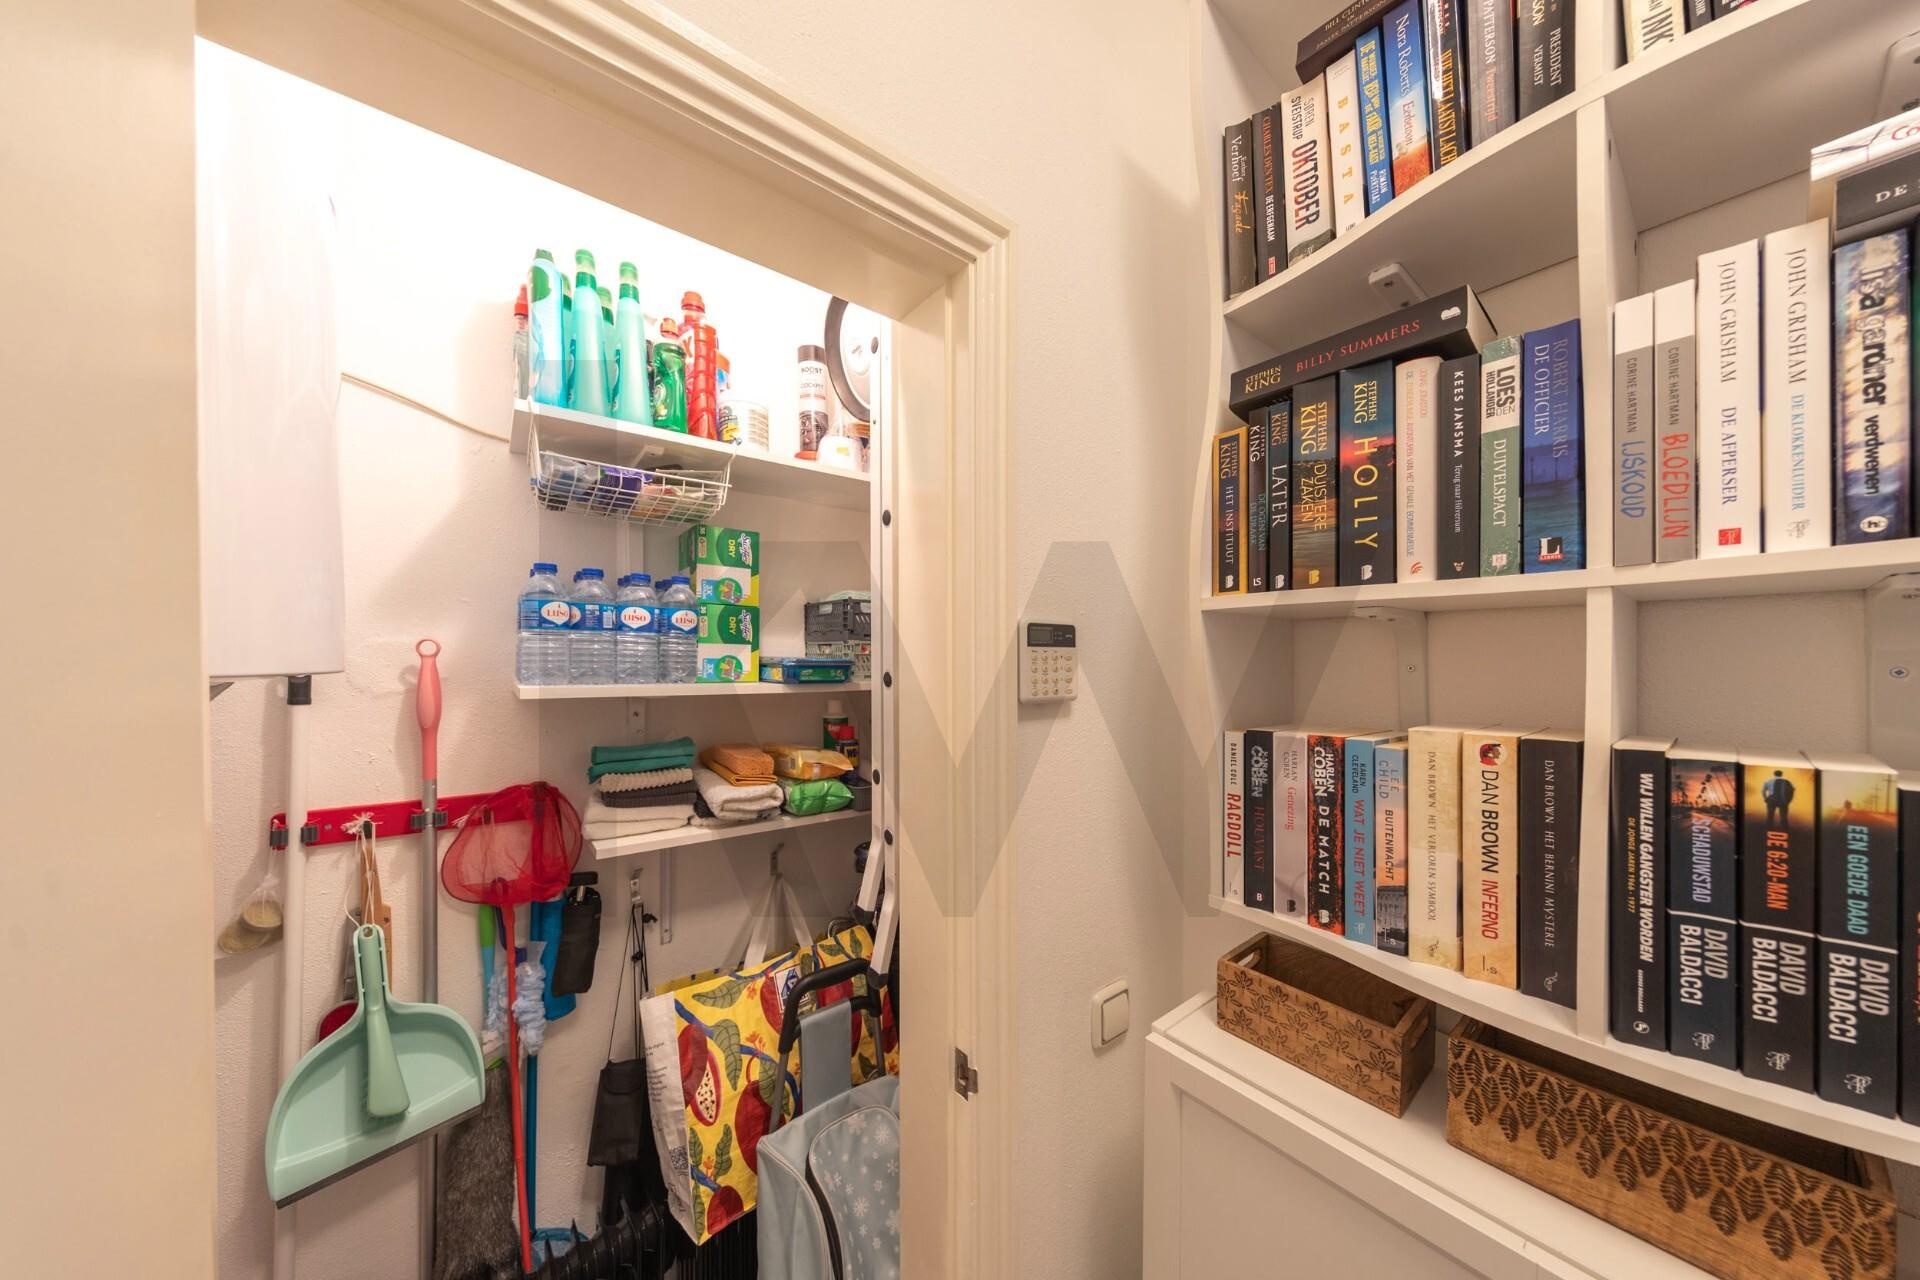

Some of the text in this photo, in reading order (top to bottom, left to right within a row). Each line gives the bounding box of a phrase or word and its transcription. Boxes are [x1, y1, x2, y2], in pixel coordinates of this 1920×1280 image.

[1396, 13, 1413, 97] Nora Roberts
[1533, 45, 1544, 86] VERMIST
[1550, 27, 1562, 87] PRESIDENT
[1291, 95, 1304, 140] SVEISTRUP
[1231, 135, 1244, 182] Verhoef
[1291, 139, 1320, 231] OKTOBER
[1265, 195, 1274, 204] DE
[1875, 184, 1908, 204] DE
[1785, 248, 1807, 298] JOHN
[1859, 262, 1892, 311] lisa
[1296, 319, 1420, 373] BILLY SUMMERS
[1788, 301, 1807, 385] GRISHAM
[1855, 313, 1895, 407] gardner
[1245, 365, 1282, 384] STEPHEN
[1245, 373, 1281, 395] KING
[1368, 380, 1377, 422] STEPHEN
[1485, 371, 1496, 419] HOLLANDER
[1496, 365, 1515, 408] LOES
[1534, 343, 1550, 436] DE OFFICIER
[1553, 337, 1569, 459] ROBERT HARRIS
[1626, 357, 1637, 433] CORINE HARTMAN
[1668, 346, 1680, 426] CORINE HARTMAN
[1717, 261, 1738, 506] JOHN GRISHAM DE AFPERSER
[1271, 414, 1282, 446] KING
[1300, 405, 1317, 455] KING
[1317, 401, 1327, 452] STEPHEN
[1354, 383, 1368, 425] KING
[1791, 394, 1805, 411] DE
[1220, 444, 1231, 480] KING
[1250, 425, 1261, 463] KING
[1453, 370, 1464, 533] KEES JANSMA Terug naar Hilversum
[1791, 412, 1806, 512] KLOKKENLUIDER
[1863, 414, 1884, 497] verdwenen
[1271, 463, 1288, 528] LATER
[1301, 476, 1314, 522] ZAKEN
[1314, 463, 1327, 531] DUISTERE
[1353, 436, 1379, 549] HOLLY
[1493, 439, 1507, 527] DUIVELSPACT
[1620, 440, 1647, 519] IJSKOUD
[1661, 432, 1691, 540] BLOEDLIJN
[728, 539, 736, 558] DRY
[1225, 486, 1234, 565] HET INSTITUUT
[547, 608, 568, 618] LUSO
[623, 613, 647, 622] LUSO
[675, 616, 696, 625] LUSO
[728, 616, 736, 636] DRY
[1251, 745, 1264, 798] COBEN
[1314, 746, 1328, 797] COBEN
[1325, 753, 1335, 793] HARLAN
[1378, 760, 1389, 799] CHILD
[1391, 769, 1399, 793] LEE
[1227, 793, 1242, 858] RAGDOLL
[1285, 786, 1297, 830] Genezing
[1627, 817, 1636, 828] DE
[1254, 806, 1265, 872] HOUVAST
[1318, 806, 1330, 895] DE MATCH
[1353, 799, 1366, 917] WAT JE NIET WEET
[1384, 808, 1394, 881] BUITENWACHT
[1428, 751, 1437, 922] DAN BROWN HET VERLOREN SYMBOOL
[1481, 769, 1500, 941] DAN BROWN INFERNO
[1544, 759, 1555, 949] DAN BROWN HET BERNINI MYSTERIE
[1627, 828, 1636, 851] JONGE
[1627, 851, 1636, 873] JAREN
[1691, 817, 1711, 904] SCHADUWSTAD
[1639, 773, 1653, 962] WIJ WILLEN GANGSTER WORDEN
[1766, 830, 1789, 910] DE 6:20-MAN
[1847, 824, 1868, 935] EEN GOEDE DAAD
[1627, 896, 1636, 913] 1977
[1680, 923, 1703, 1006] BALDACCI
[1704, 927, 1728, 980] DAVID
[1752, 936, 1777, 1024] BALDACCI
[1779, 940, 1806, 996] DAVID
[1828, 951, 1857, 1044] BALDACCI
[1860, 957, 1889, 1016] DAVID
